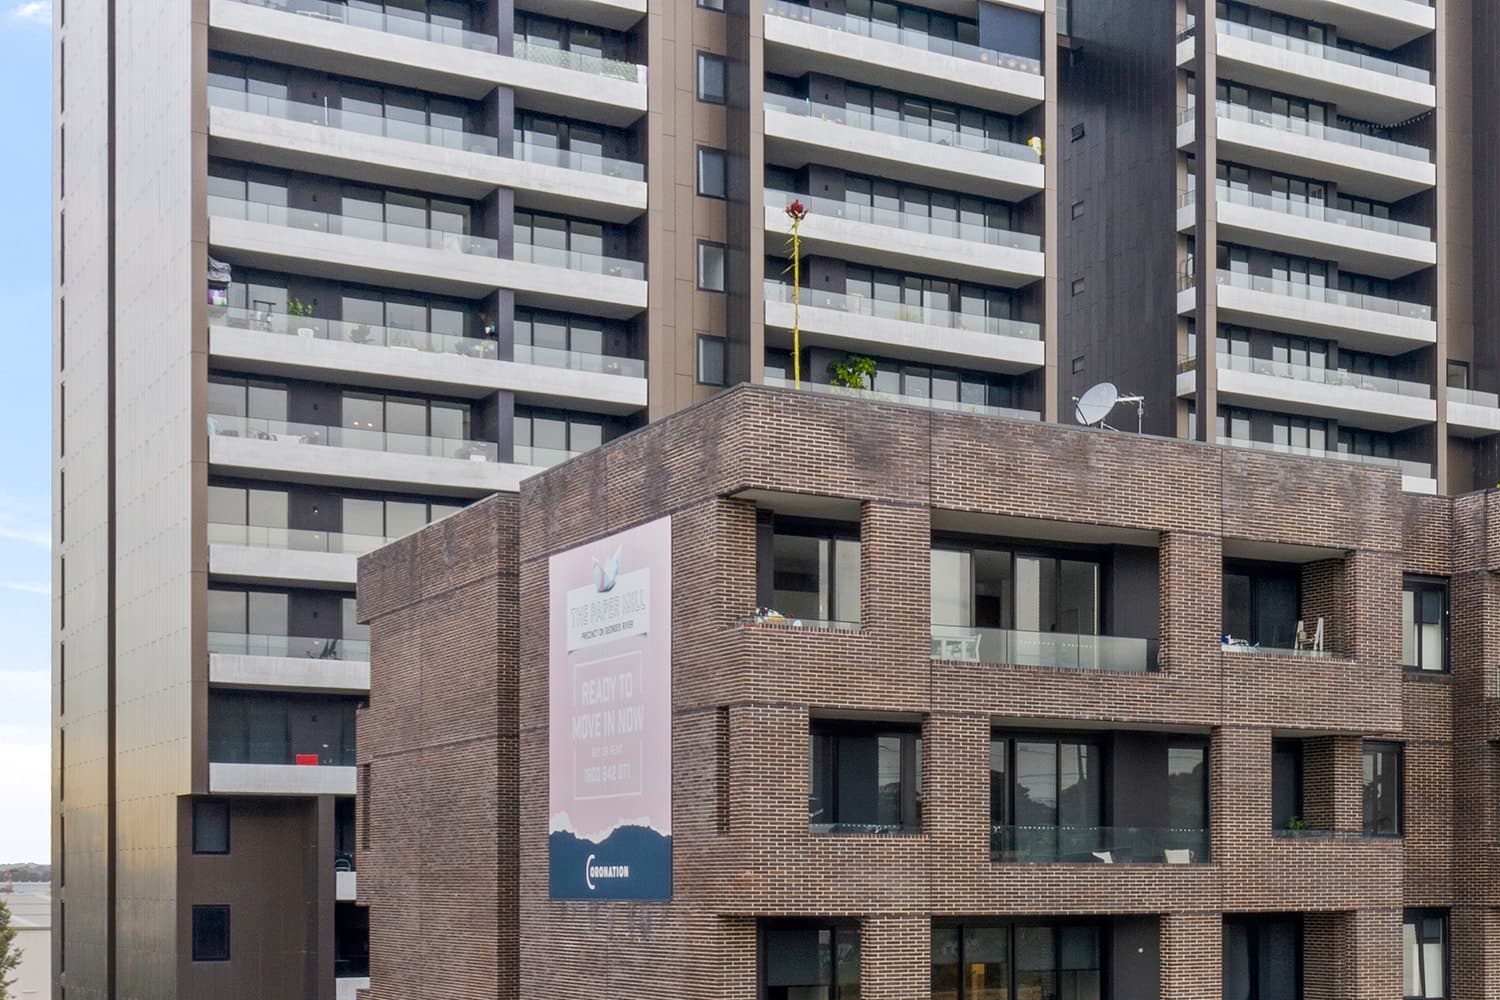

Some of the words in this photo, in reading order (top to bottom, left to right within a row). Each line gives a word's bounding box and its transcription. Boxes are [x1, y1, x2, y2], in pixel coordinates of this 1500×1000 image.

[570, 603, 589, 629] THE
[591, 595, 620, 623] PAPER
[623, 589, 646, 613] MILL
[581, 675, 617, 705] READY
[618, 671, 633, 701] TO
[572, 711, 601, 741] MOVE
[604, 709, 615, 737] IN
[618, 703, 644, 735] NOW
[586, 854, 629, 890] CORONATION
